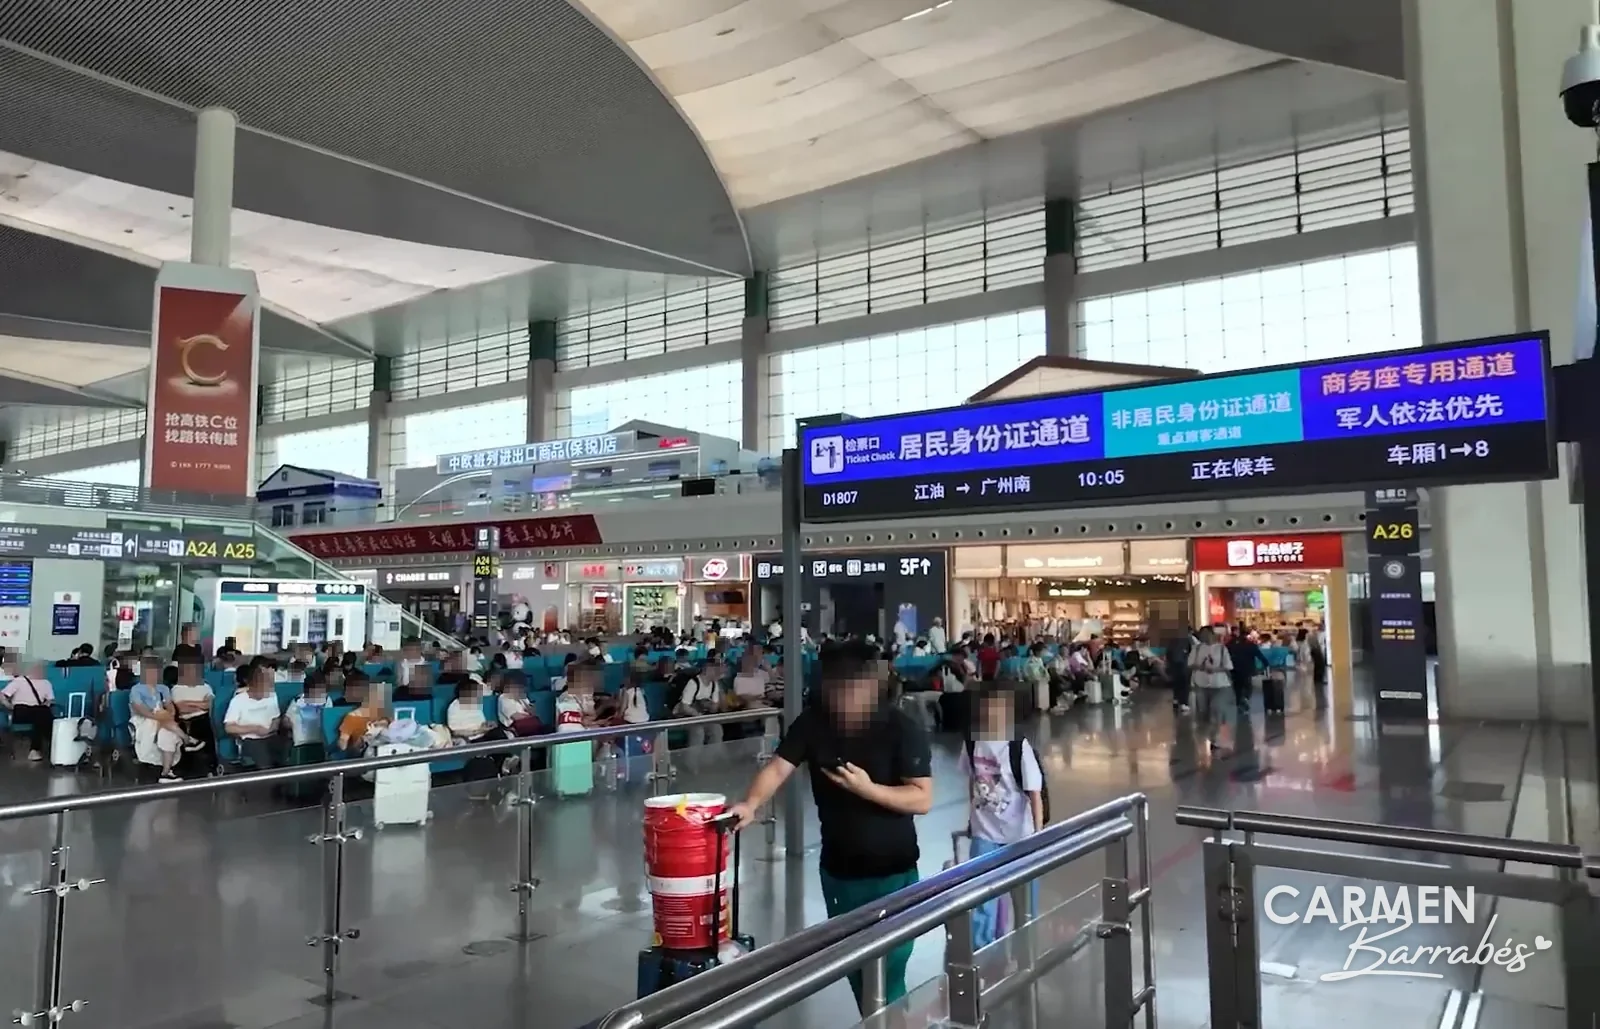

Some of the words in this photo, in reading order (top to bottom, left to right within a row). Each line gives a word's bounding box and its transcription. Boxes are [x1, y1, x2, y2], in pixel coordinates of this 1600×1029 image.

[1321, 351, 1517, 396] 商务座专用通道
[1111, 391, 1292, 429] 非居民身份证通道
[1336, 393, 1504, 430] 军人依法优先
[165, 412, 238, 430] 抢高铁C位
[165, 428, 238, 446] 找路铁传媒
[845, 436, 880, 453] 检票口
[899, 414, 1090, 460] 居民身份证通道
[449, 435, 617, 472] 中欧班列进出口商品(保税)店
[845, 453, 870, 465] Ticket
[870, 450, 896, 463] Check
[1191, 457, 1276, 481] 正在候车
[914, 483, 945, 501] 江油
[980, 475, 1031, 497] 广州南
[1078, 470, 1125, 488] 10:05
[823, 490, 858, 506] D1807
[1372, 523, 1413, 540] A26
[185, 540, 217, 558] A24
[223, 542, 255, 559] A25
[475, 556, 491, 566] A24
[900, 558, 919, 575] 3F
[475, 566, 491, 576] A25
